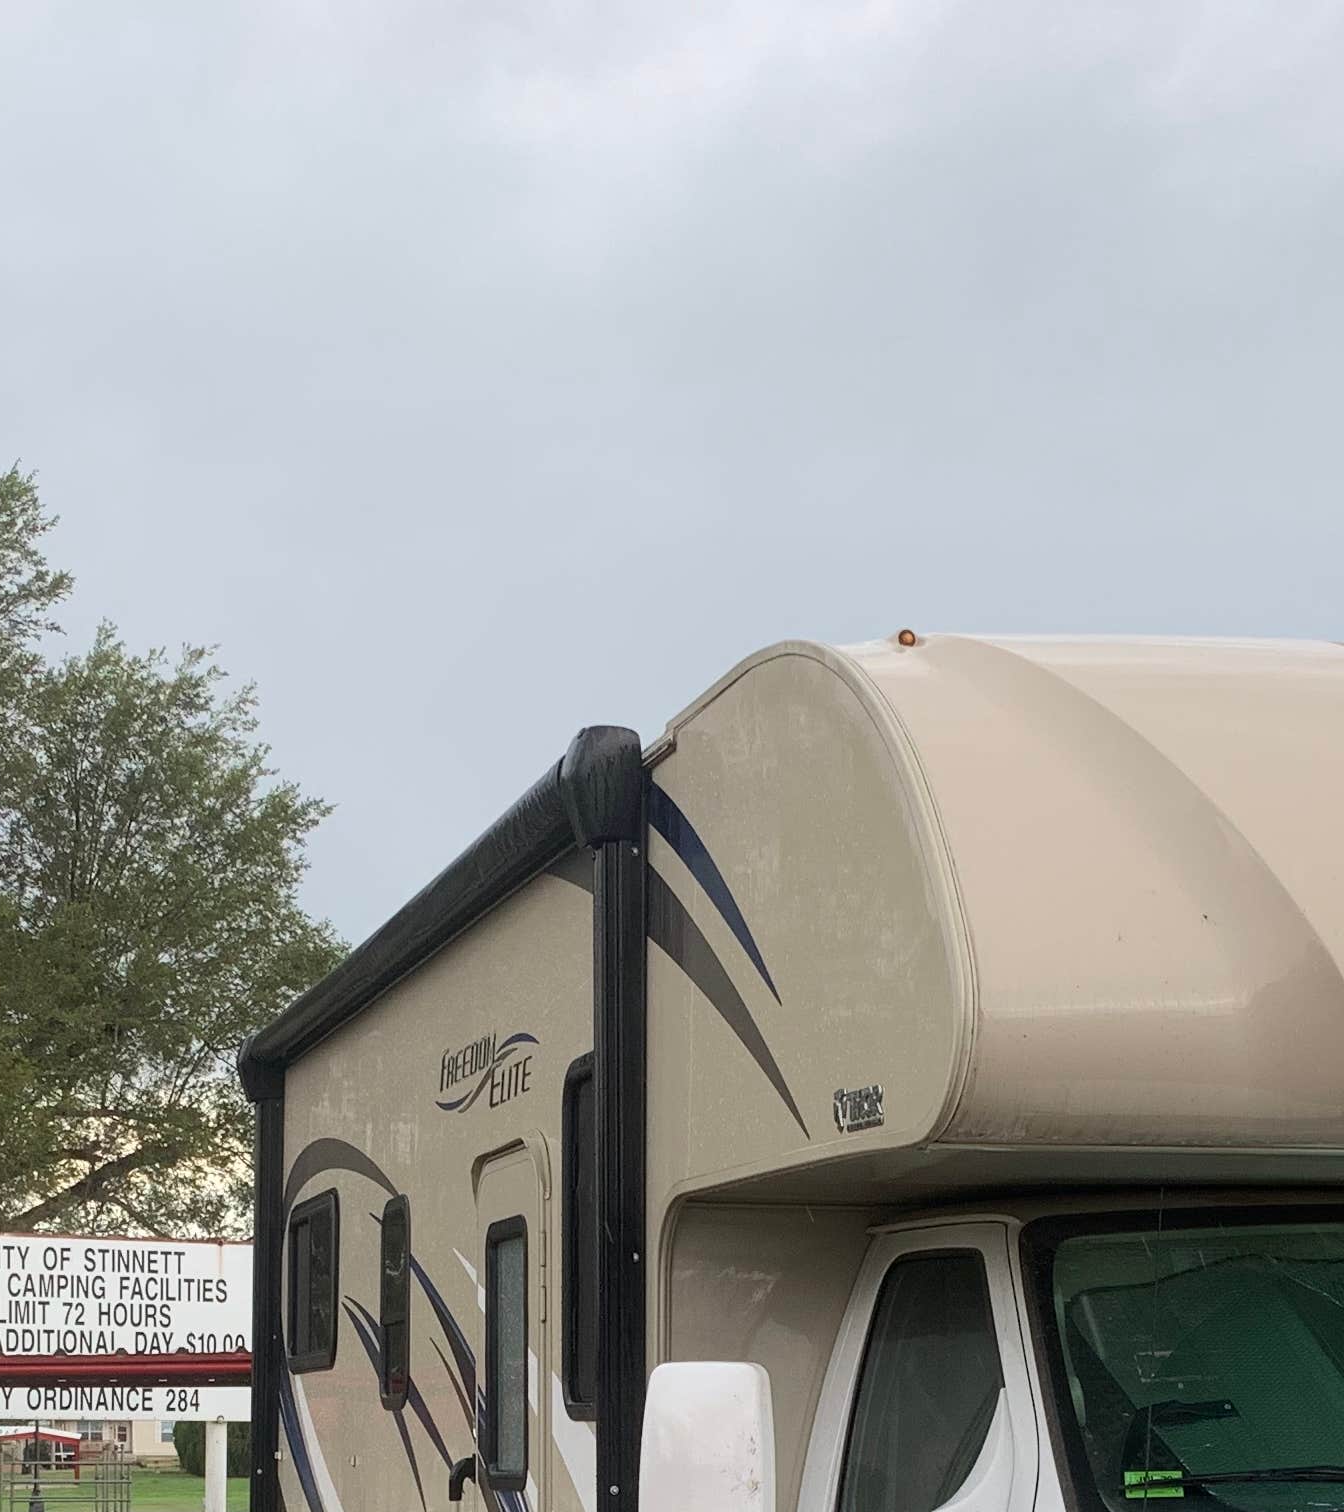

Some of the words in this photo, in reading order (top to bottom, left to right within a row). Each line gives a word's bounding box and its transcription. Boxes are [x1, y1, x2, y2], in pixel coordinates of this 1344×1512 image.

[42, 1247, 71, 1271] OF
[84, 1248, 186, 1275] STINNETT
[7, 1273, 106, 1299] CAMPING
[119, 1277, 228, 1303] FACILITIES
[62, 1302, 84, 1325] 72
[98, 1303, 172, 1328] HOURS
[135, 1332, 173, 1354] DAY
[186, 1332, 245, 1353] $1000
[26, 1386, 153, 1411] ORDINANCE
[166, 1388, 200, 1412] 284
